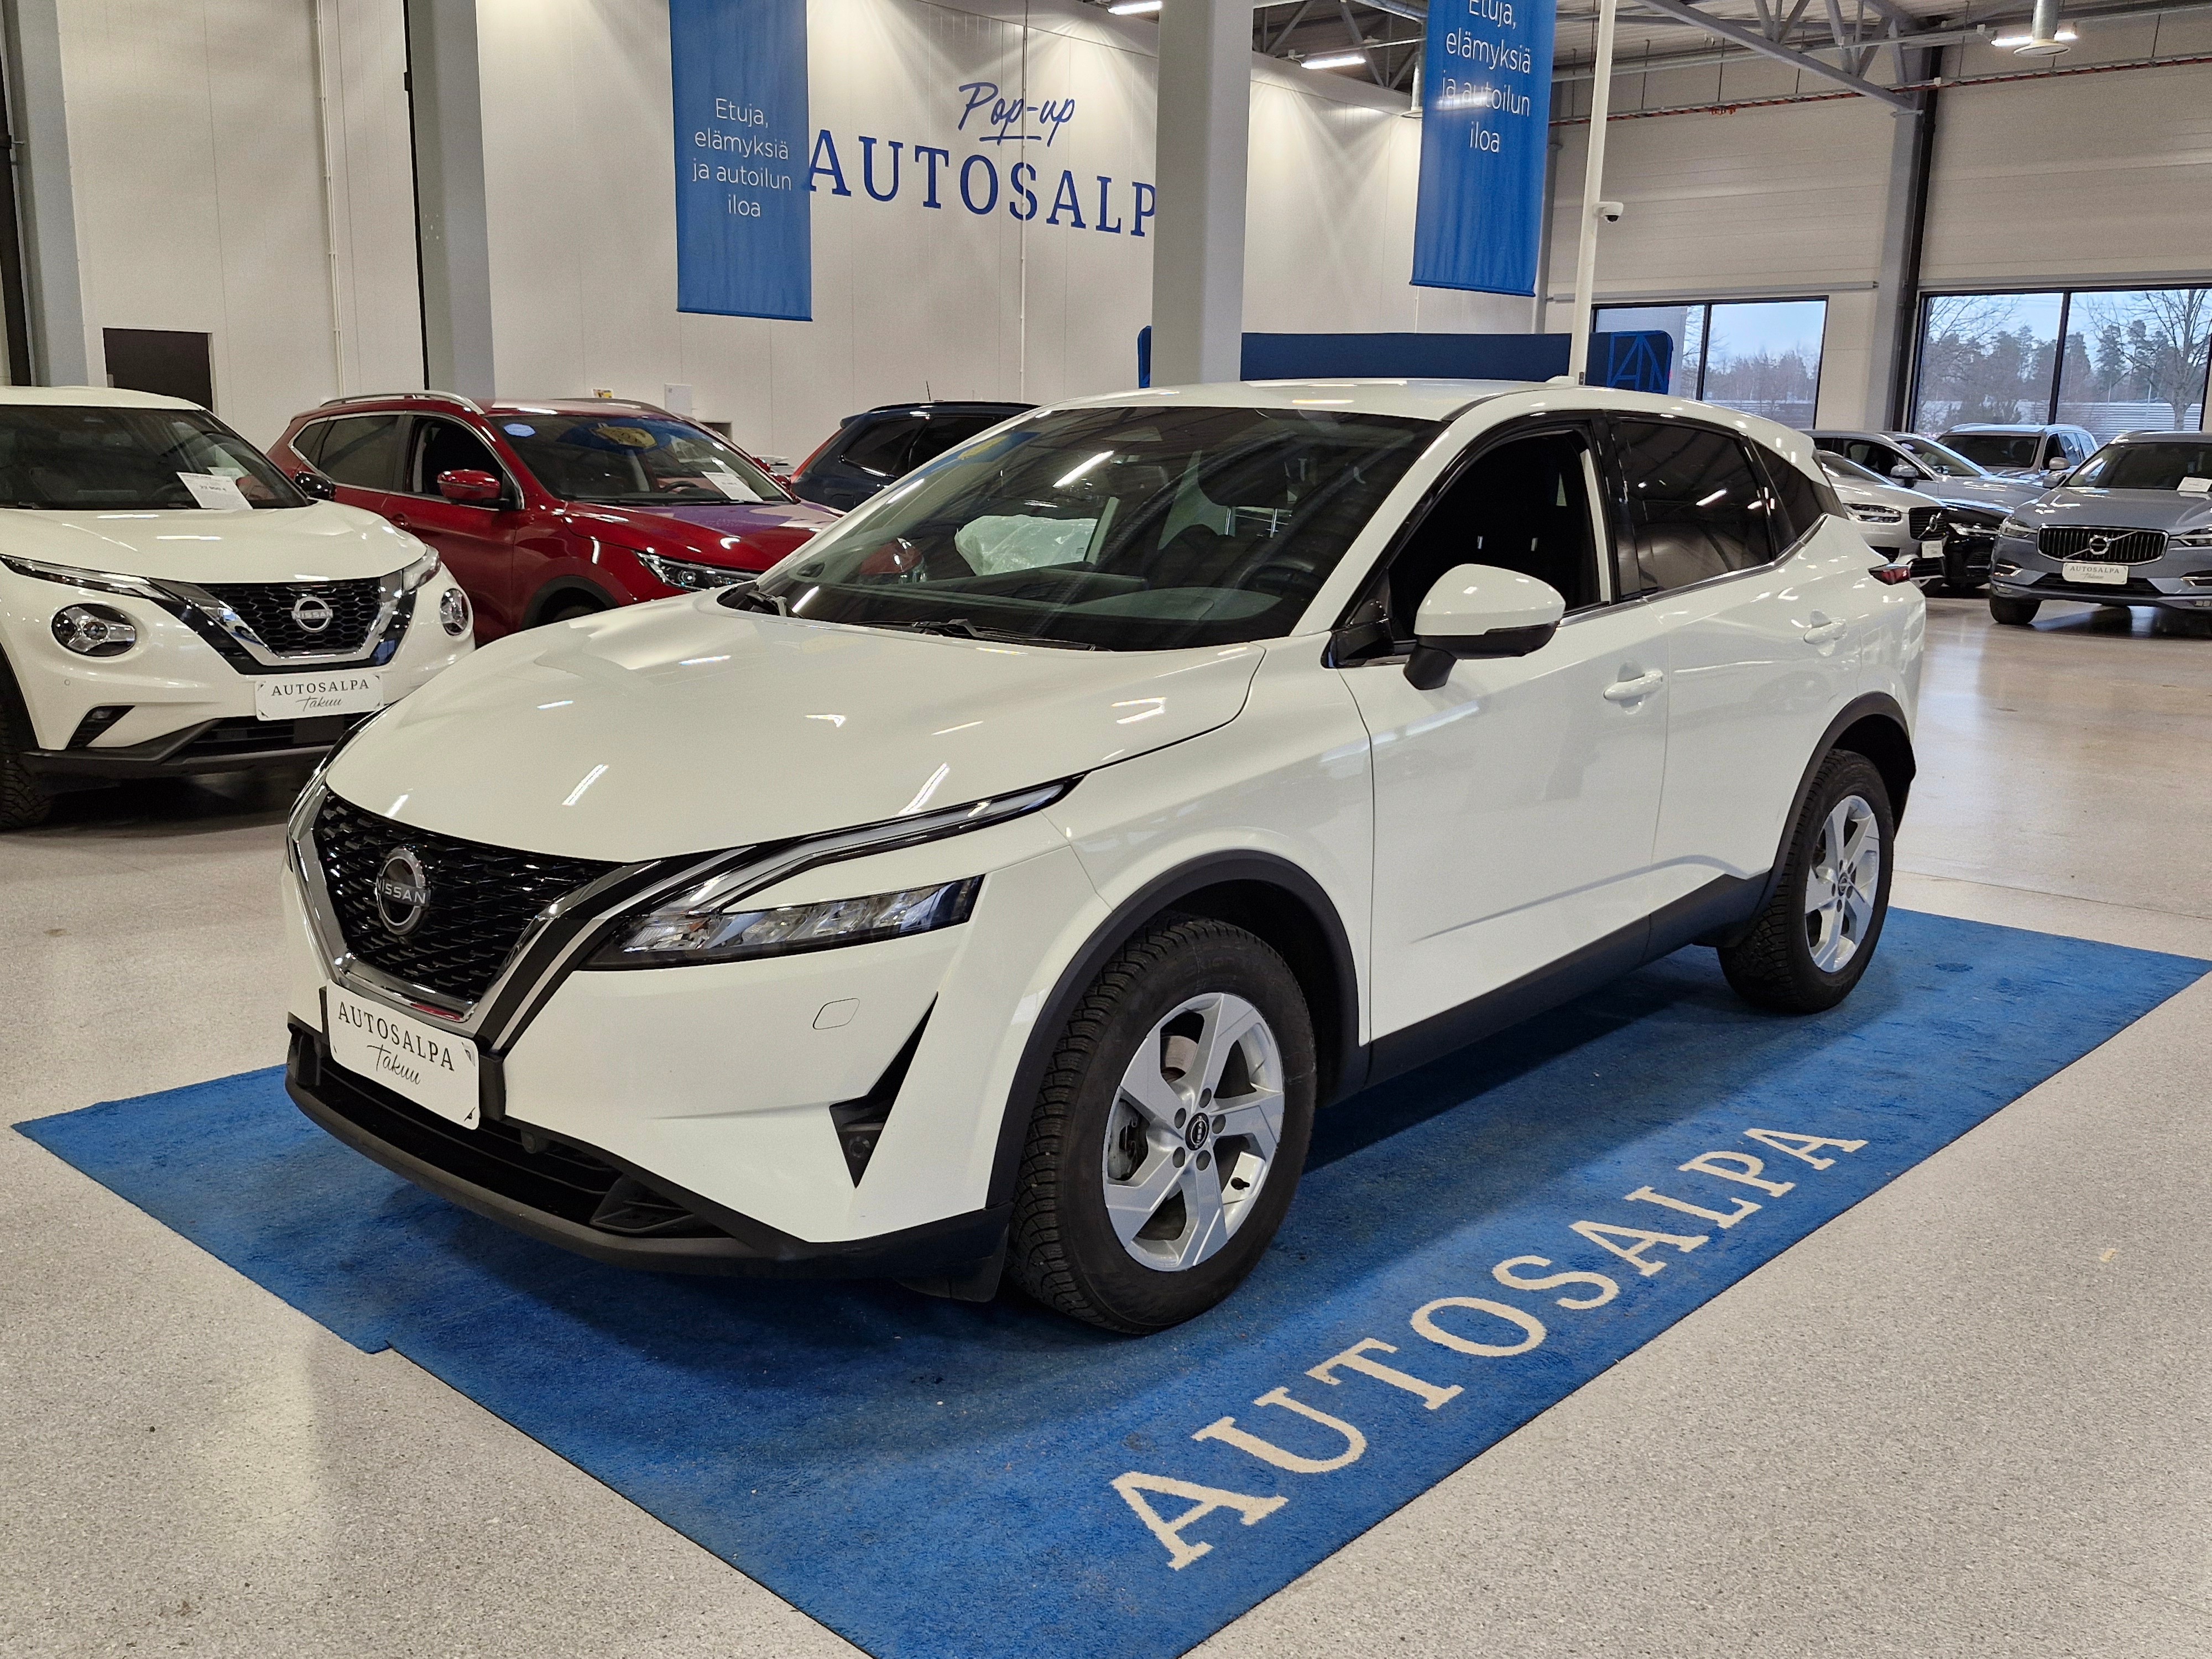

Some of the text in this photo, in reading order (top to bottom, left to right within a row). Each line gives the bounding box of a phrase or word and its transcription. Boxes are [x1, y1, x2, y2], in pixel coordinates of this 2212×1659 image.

[1446, 27, 1531, 74] elämyksiä
[1438, 70, 1530, 117] ja autoilun
[715, 98, 768, 128] Etuja,
[958, 82, 1076, 147] Pop-up
[695, 128, 789, 160] elämyksiä
[1469, 121, 1500, 153] iloa
[692, 158, 791, 191] ja autoilun
[728, 194, 761, 217] iloa
[291, 610, 333, 619] NISSAN
[271, 679, 369, 696] AUTOSALPA
[295, 696, 343, 712] Takuu
[376, 877, 426, 904] NISSAN
[338, 1001, 455, 1072] AUTOSALPA
[367, 1044, 421, 1085] Takuu
[1110, 1128, 1869, 1570] AUTOSALPA
